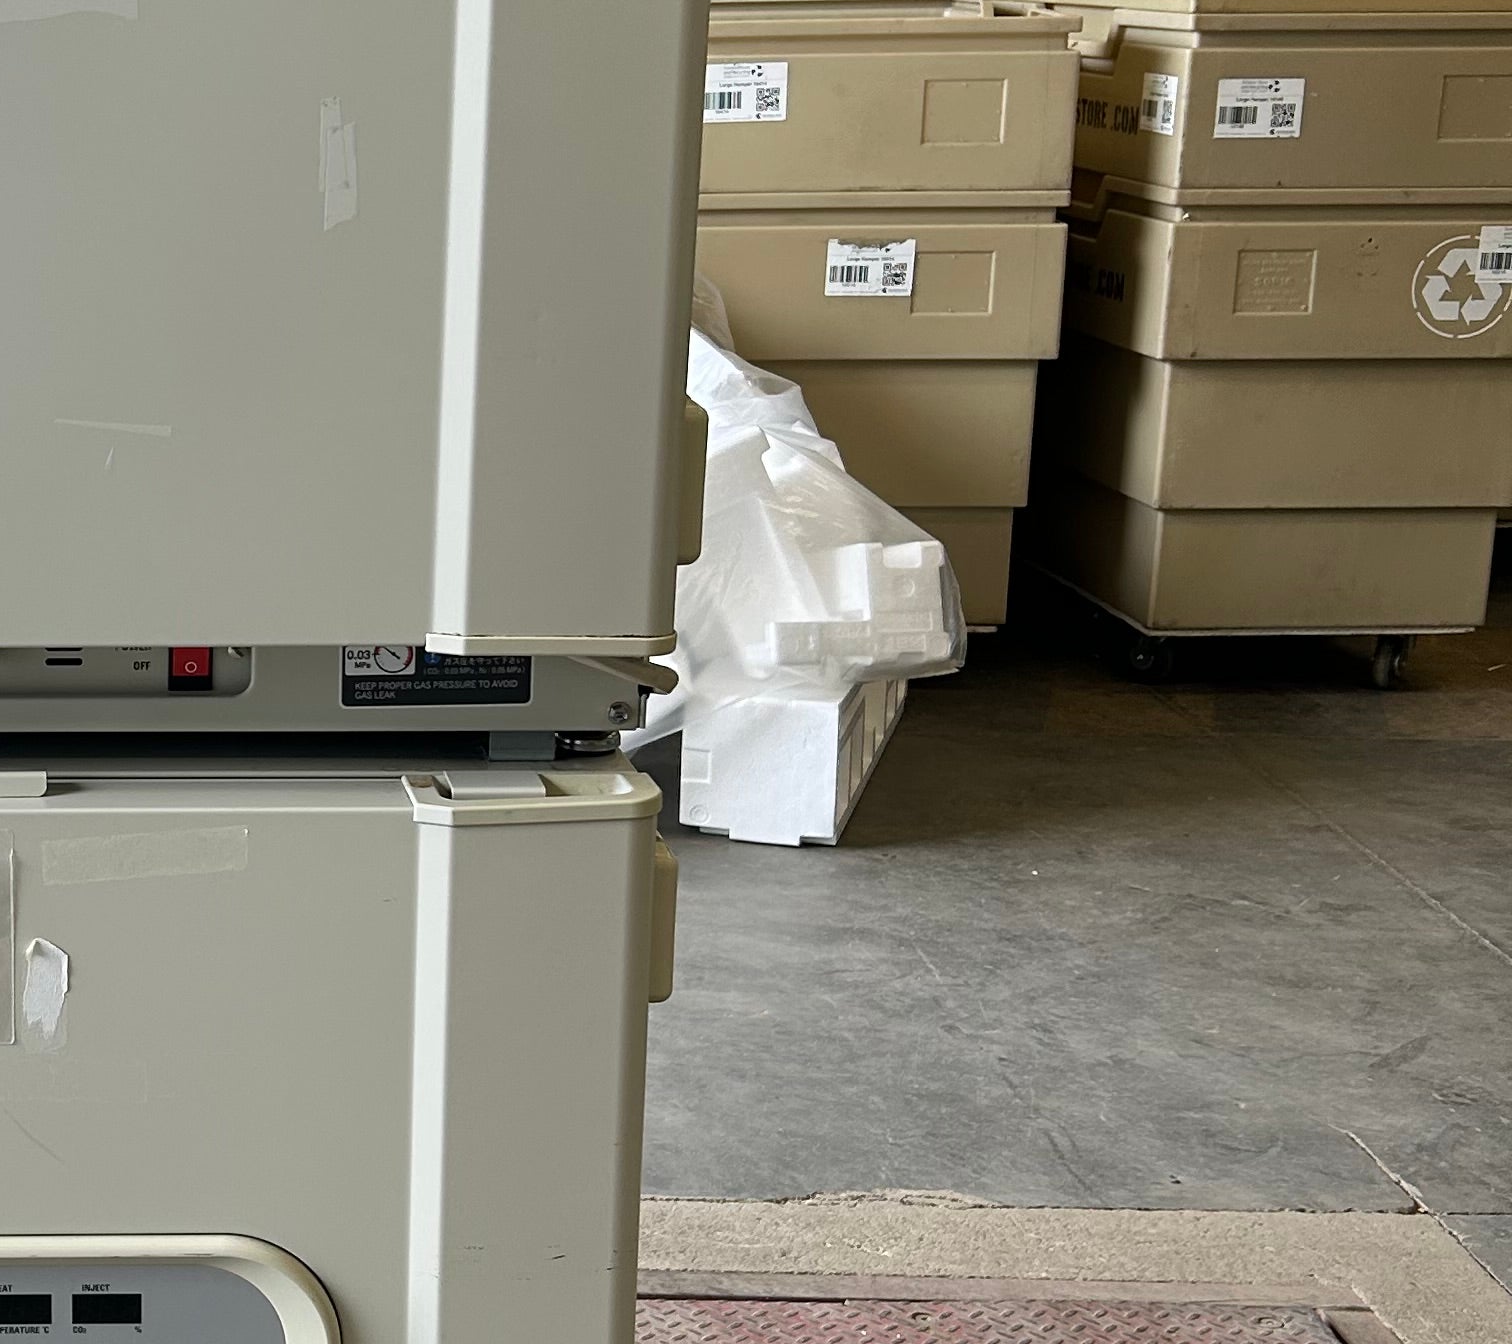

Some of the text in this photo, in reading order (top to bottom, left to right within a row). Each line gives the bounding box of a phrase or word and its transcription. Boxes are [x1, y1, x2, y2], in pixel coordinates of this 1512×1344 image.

[347, 650, 371, 660] 0.03
[133, 661, 151, 671] OFF
[354, 661, 371, 669] MPa
[354, 680, 518, 690] KEEP PROPER GAS PRESSURE TO AVOID
[354, 691, 396, 700] GAS LEAK
[81, 1284, 110, 1292] INJECT
